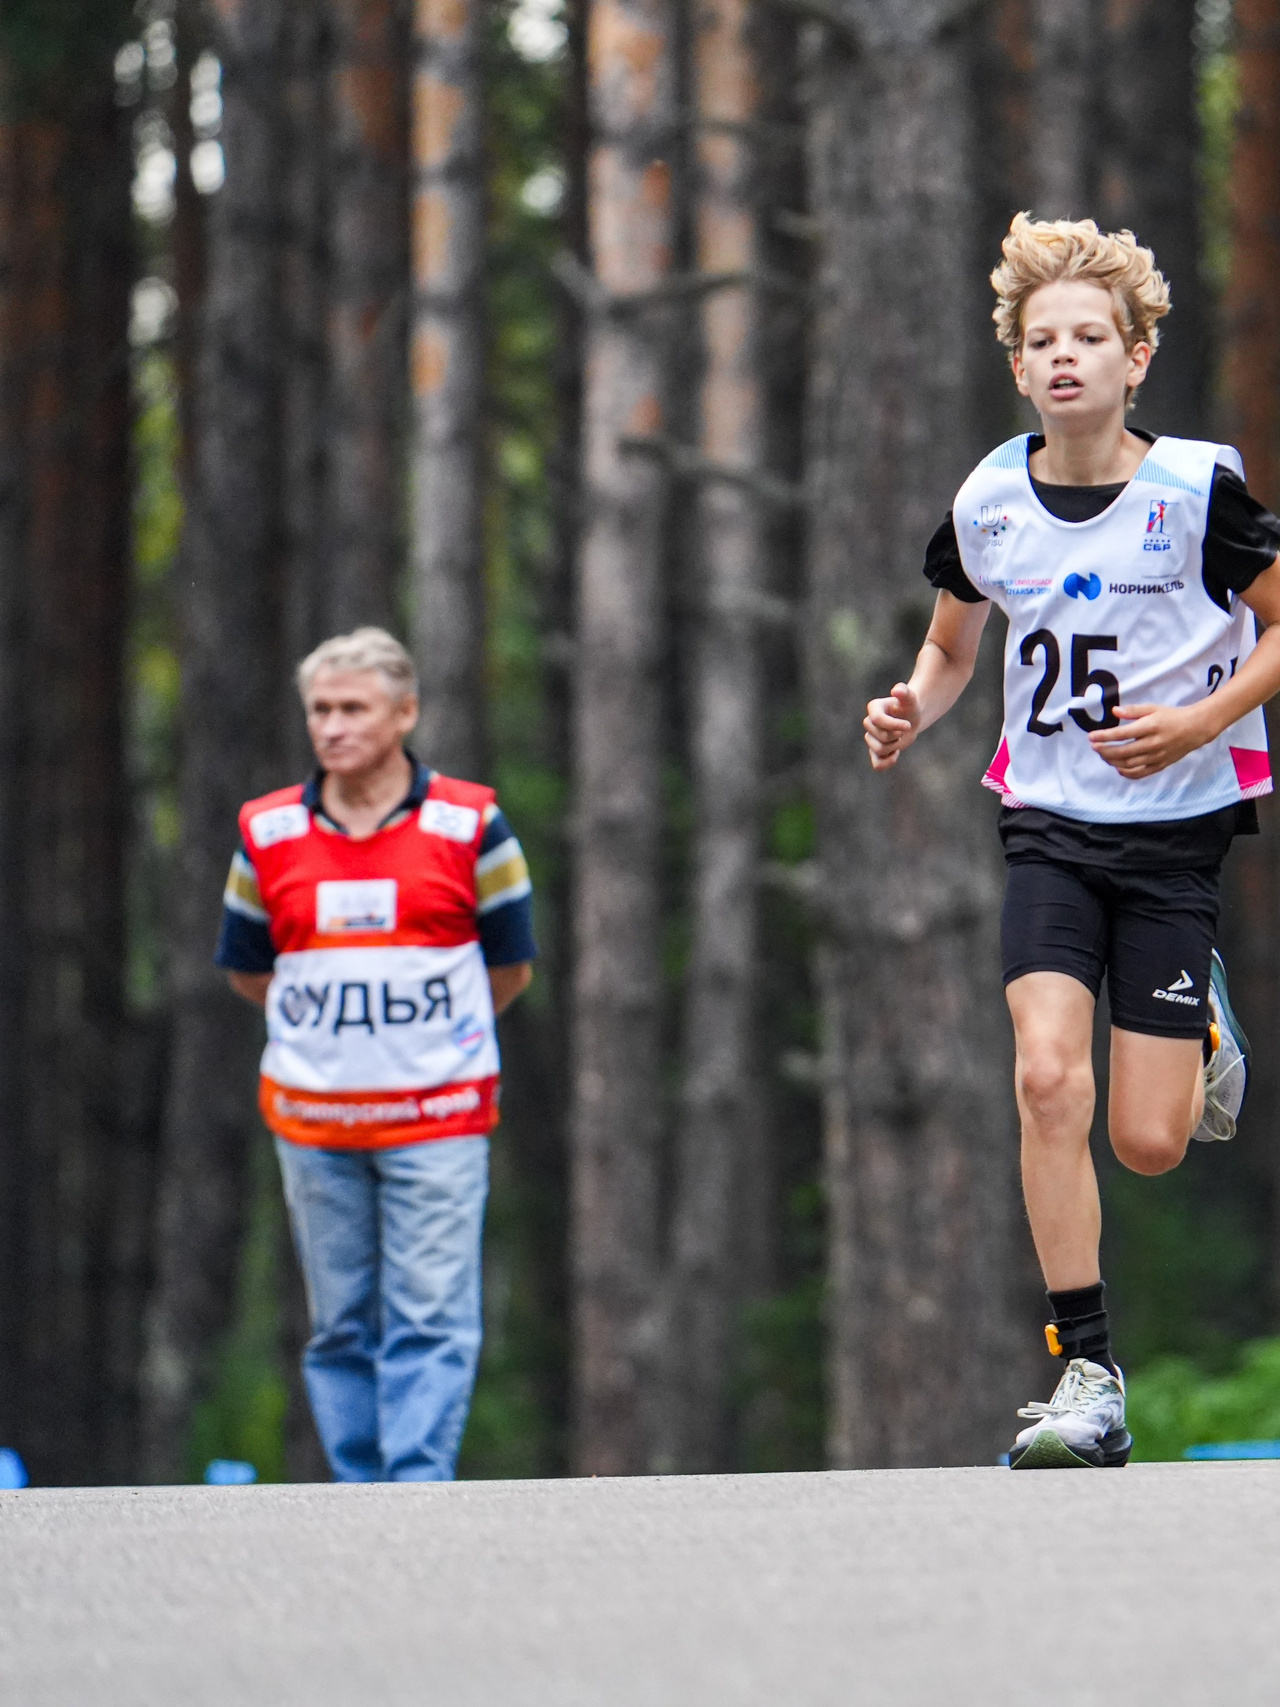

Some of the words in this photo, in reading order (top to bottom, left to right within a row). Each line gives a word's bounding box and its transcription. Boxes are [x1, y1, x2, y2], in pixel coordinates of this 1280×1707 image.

[1143, 543, 1171, 551] СБР
[1109, 579, 1185, 595] НОРНИКЕЛЬ
[1019, 628, 1120, 737] 25
[1152, 989, 1201, 1006] DEMIX
